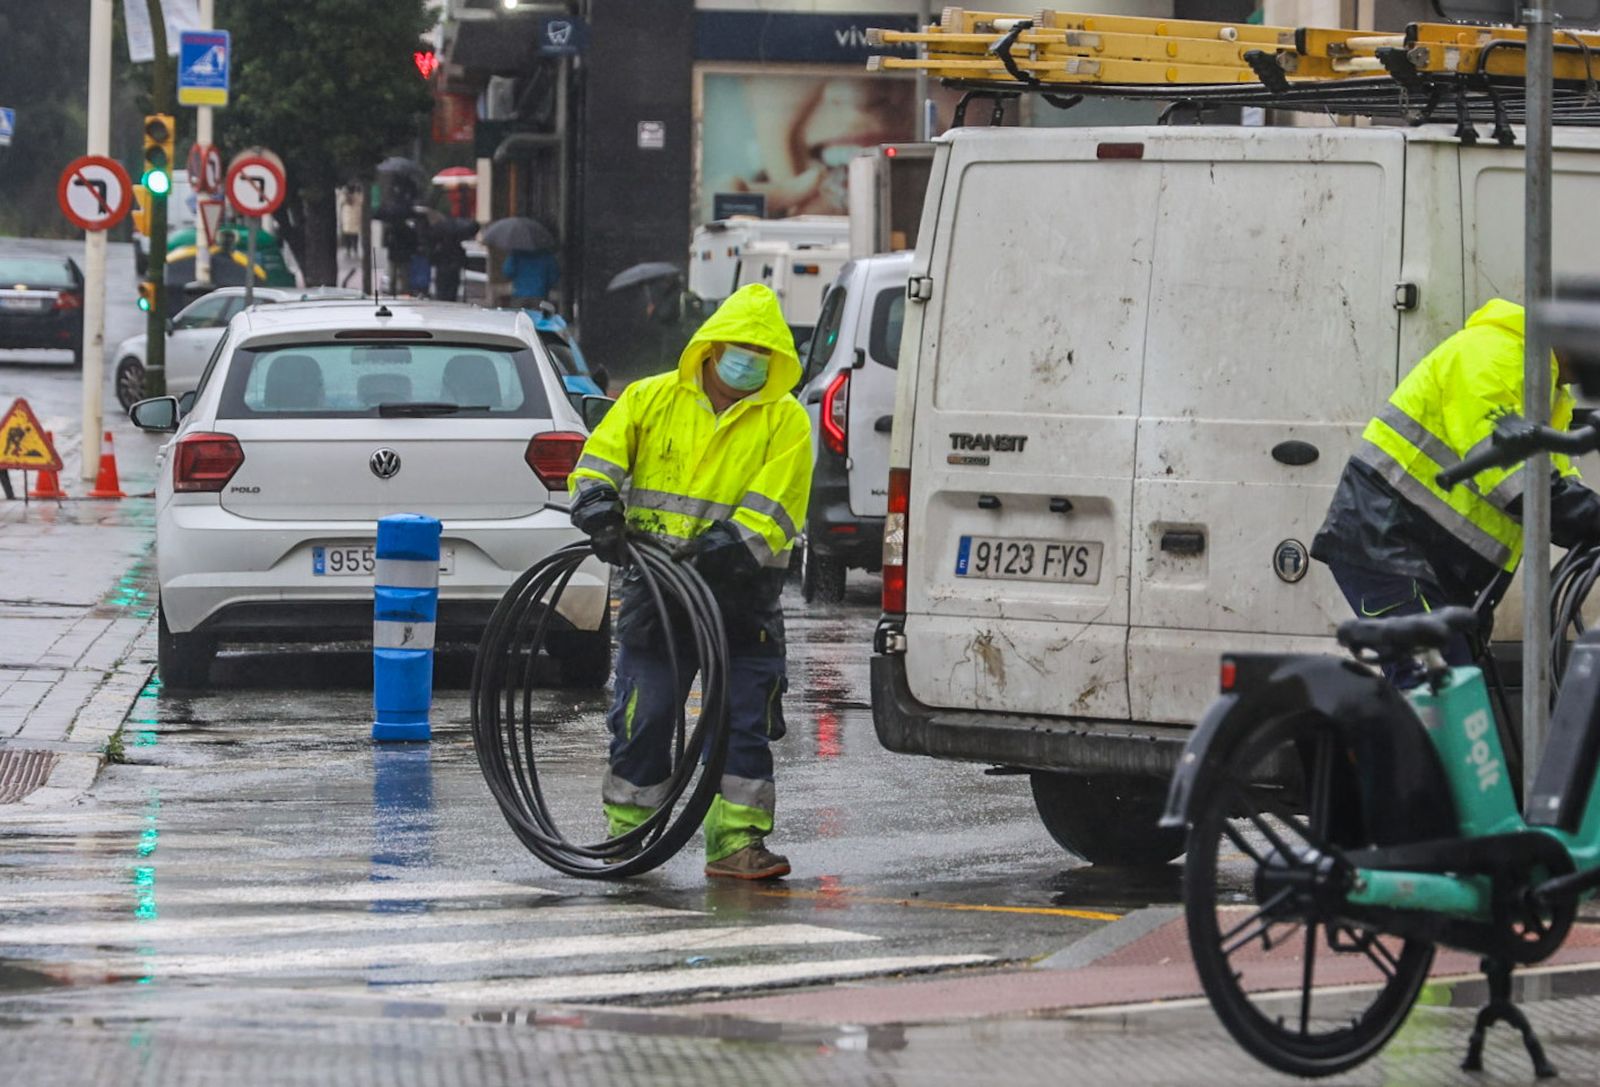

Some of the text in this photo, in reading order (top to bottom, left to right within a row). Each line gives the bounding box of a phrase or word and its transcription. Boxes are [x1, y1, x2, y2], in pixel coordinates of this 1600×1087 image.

[948, 432, 1028, 453] TRANSIT
[231, 486, 261, 494] POLO
[330, 549, 376, 572] 955
[975, 541, 1035, 574] 9123
[1042, 544, 1089, 577] FYS
[1463, 708, 1500, 792] Bolt
